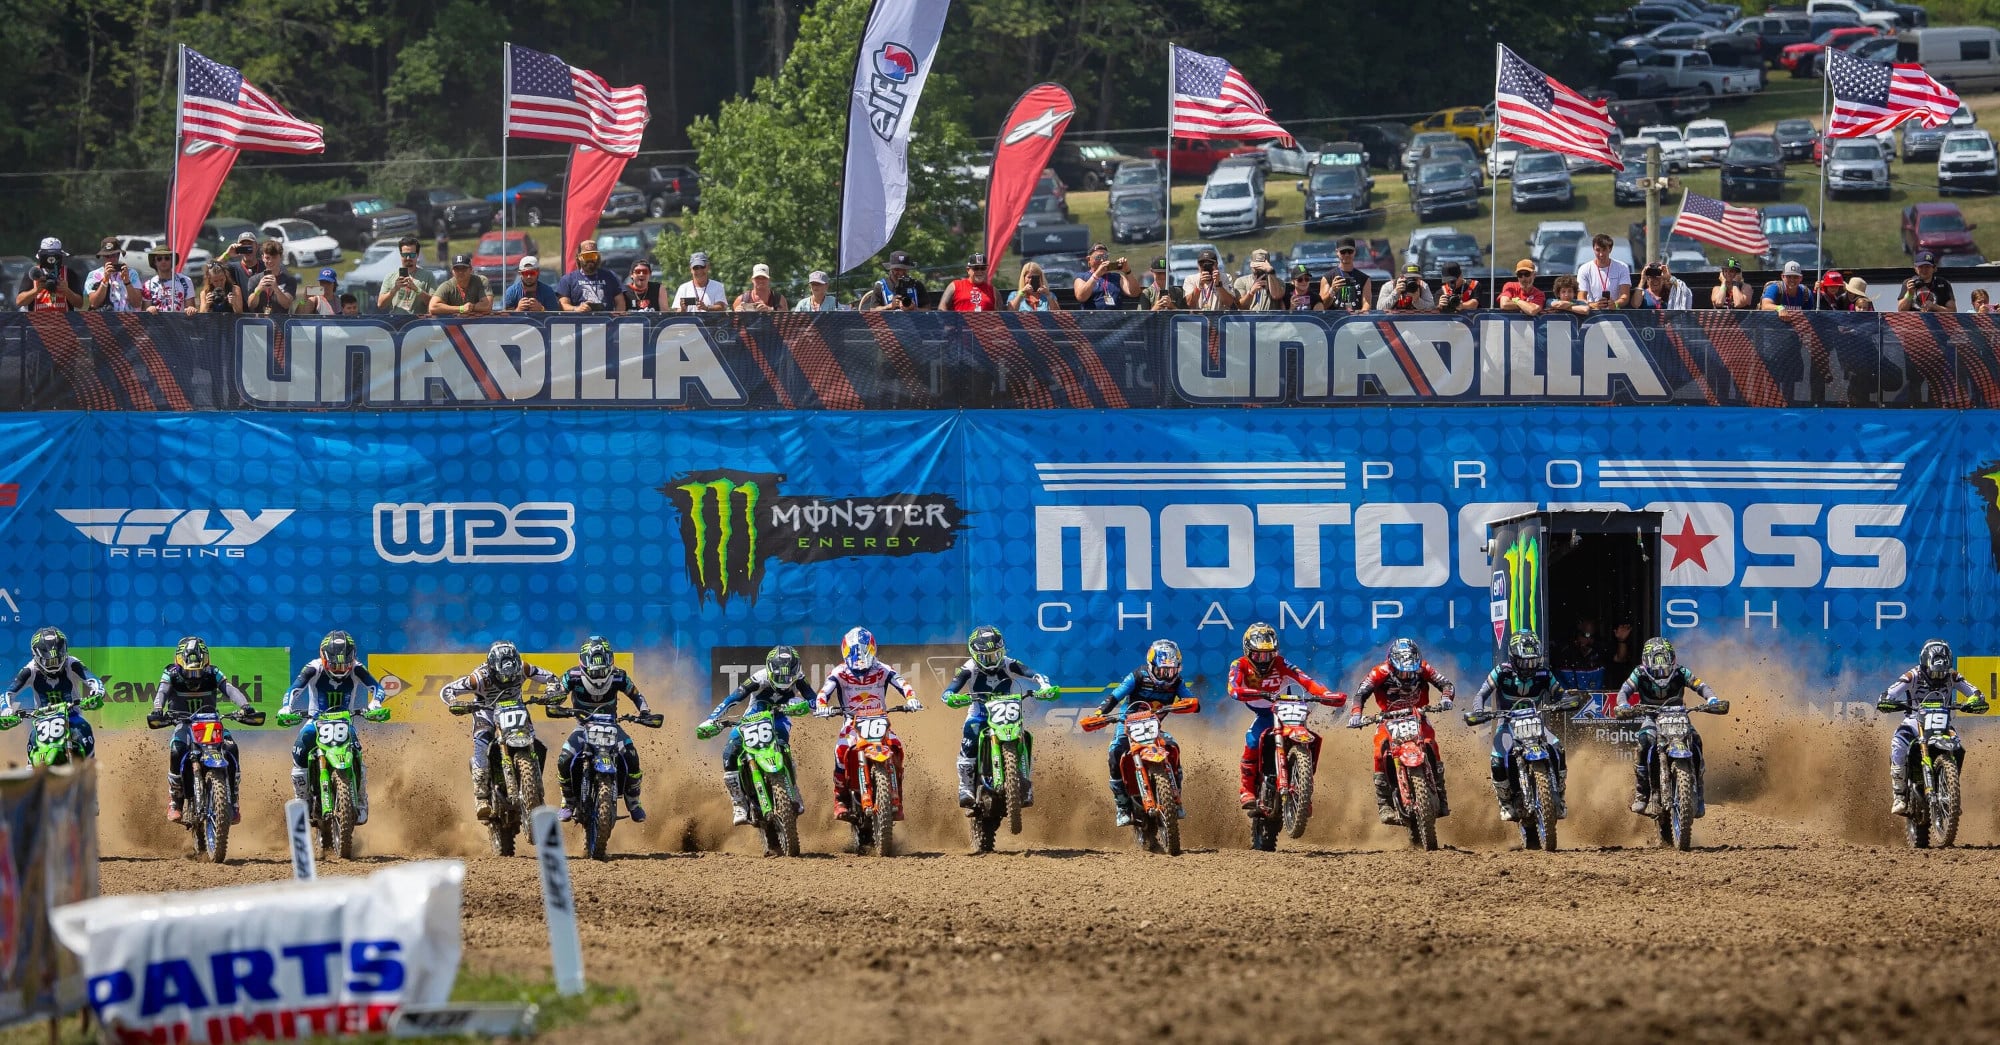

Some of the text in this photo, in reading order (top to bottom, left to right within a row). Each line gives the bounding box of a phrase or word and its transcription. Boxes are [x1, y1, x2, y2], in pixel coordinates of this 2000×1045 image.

[240, 320, 743, 402] UNADILLA
[1176, 318, 1668, 398] UNADILLA
[1362, 459, 1582, 490] PRO
[54, 508, 297, 545] FLY
[771, 500, 951, 533] MONSTER
[373, 502, 576, 564] WPS
[798, 536, 921, 549] ENERGY
[110, 548, 245, 559] RACING
[1035, 501, 1907, 591] MOTOOSS
[1037, 600, 1907, 633] CHAMPISHIP
[83, 675, 262, 702] Kawki
[499, 710, 527, 729] 107
[991, 702, 1020, 723] 26
[1278, 704, 1308, 721] 25
[1924, 712, 1948, 730] 19
[37, 718, 65, 742] 36
[201, 722, 216, 743] 1
[319, 722, 350, 744] 98
[588, 725, 618, 746] 93
[744, 723, 773, 747] 56
[857, 718, 888, 739] 16
[1129, 720, 1159, 741] 23
[87, 940, 406, 1018] PARTS
